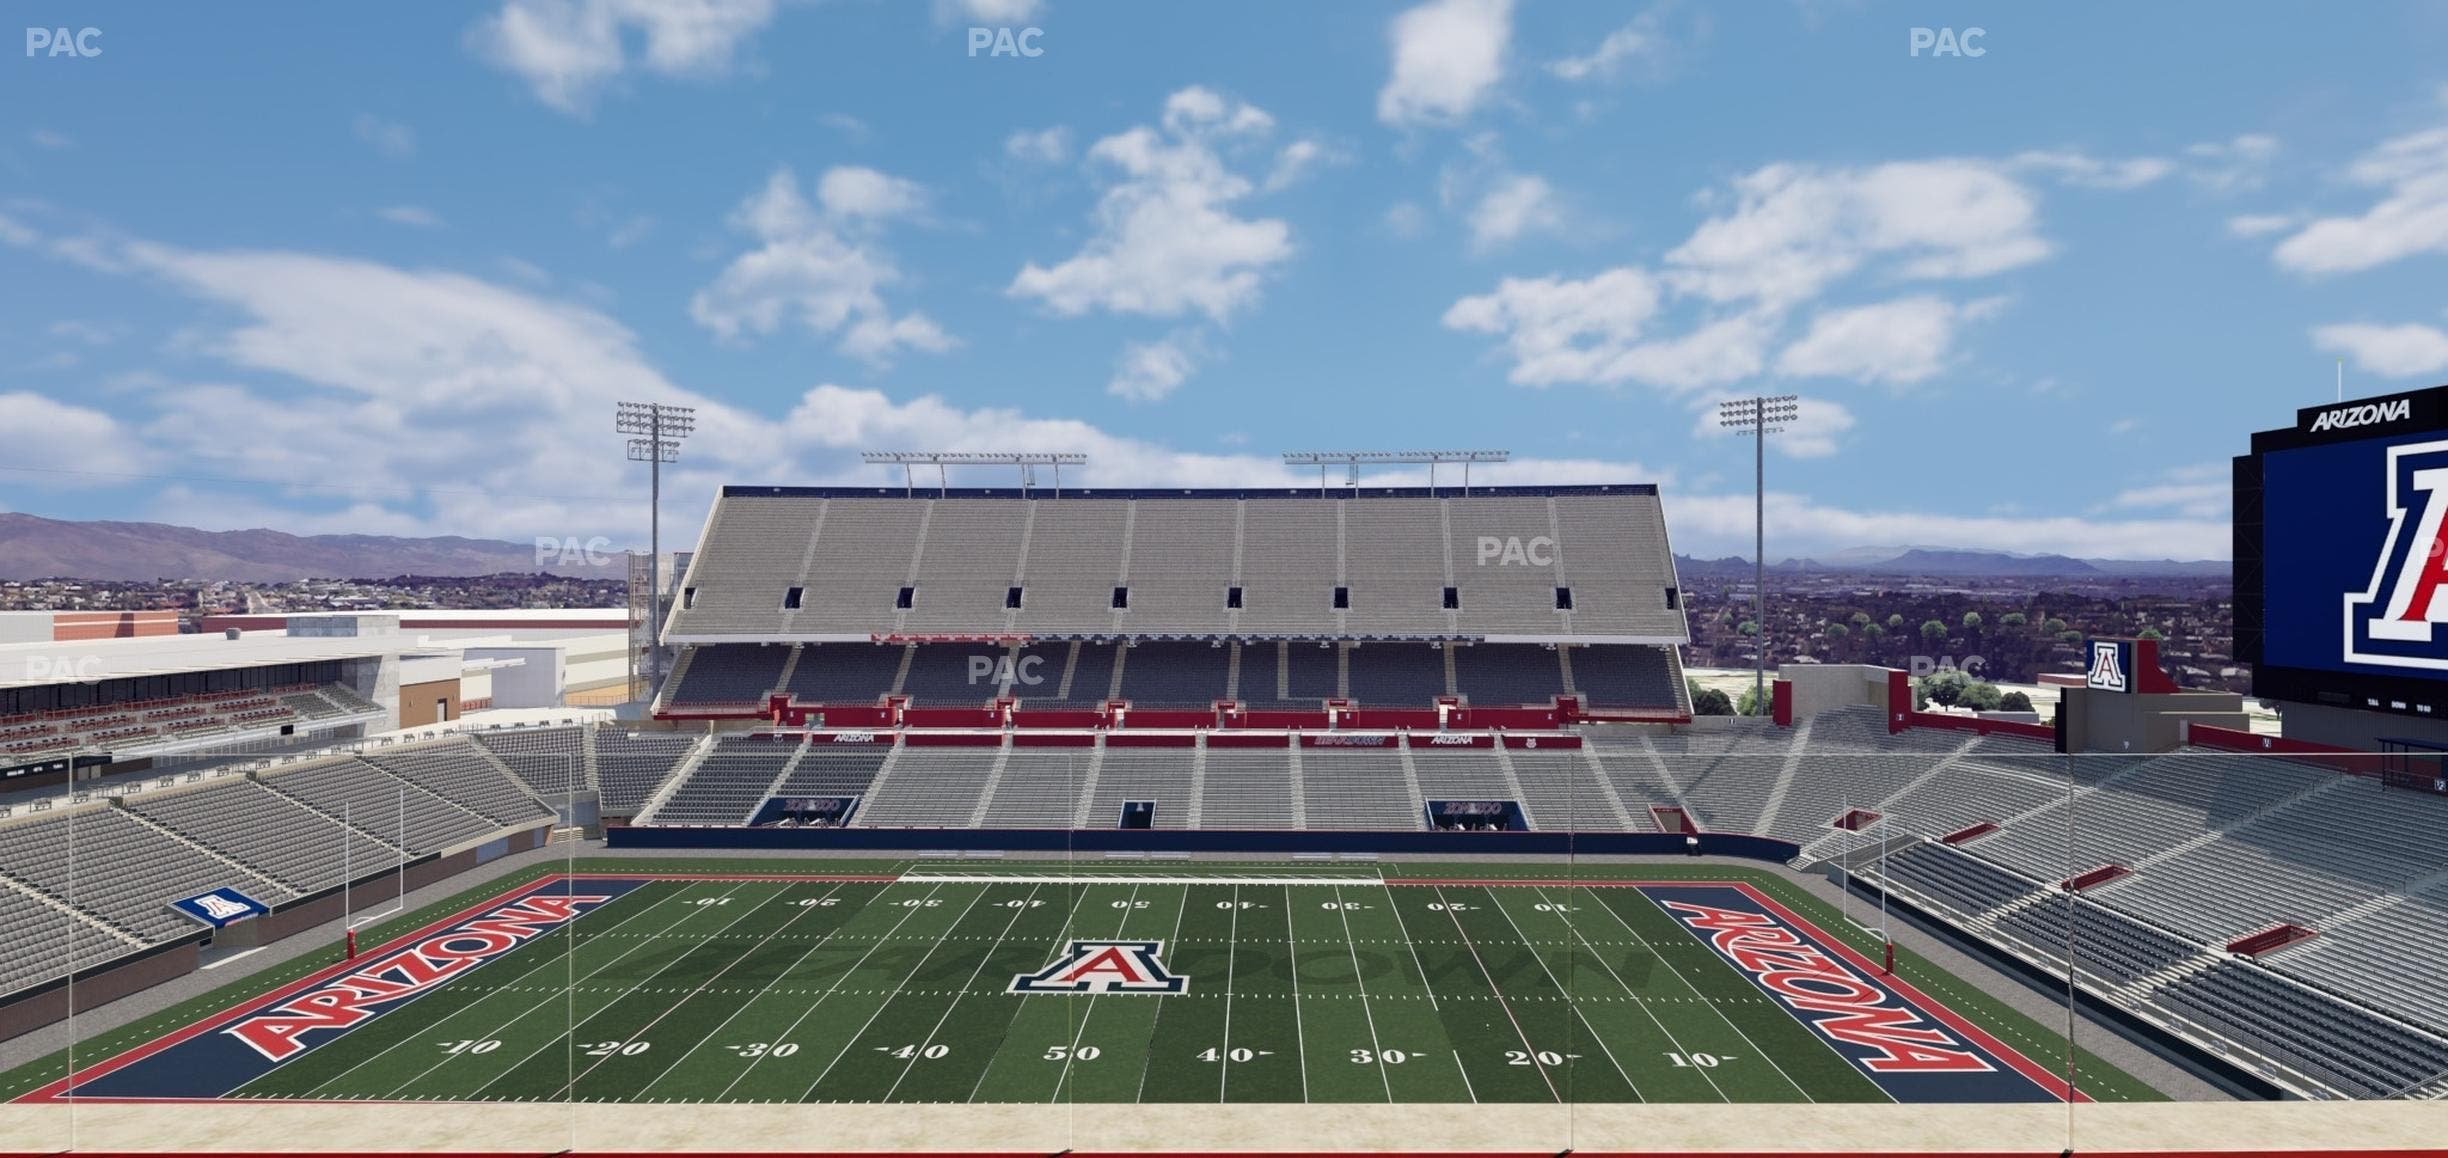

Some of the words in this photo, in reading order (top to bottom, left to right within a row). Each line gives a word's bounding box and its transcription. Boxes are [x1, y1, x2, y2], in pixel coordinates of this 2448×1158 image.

[2310, 399, 2410, 432] ARIZONA
[2088, 642, 2125, 692] A
[833, 734, 874, 743] ARIZONA
[1431, 735, 1473, 745] ARIZONA
[193, 895, 251, 919] A
[1006, 940, 1190, 994] A
[1169, 948, 1651, 988] DOWN
[220, 895, 612, 1062] ARIZONA
[1661, 900, 1999, 1072] ARIZONA
[444, 1040, 501, 1054] 10
[586, 1041, 650, 1056] 20
[739, 1043, 799, 1057] 30
[890, 1044, 950, 1059] 40
[1043, 1045, 1100, 1060] 50
[1196, 1047, 1253, 1062] 40
[1350, 1049, 1406, 1064] 30
[1505, 1050, 1563, 1066] 20
[1662, 1052, 1719, 1068] 10
